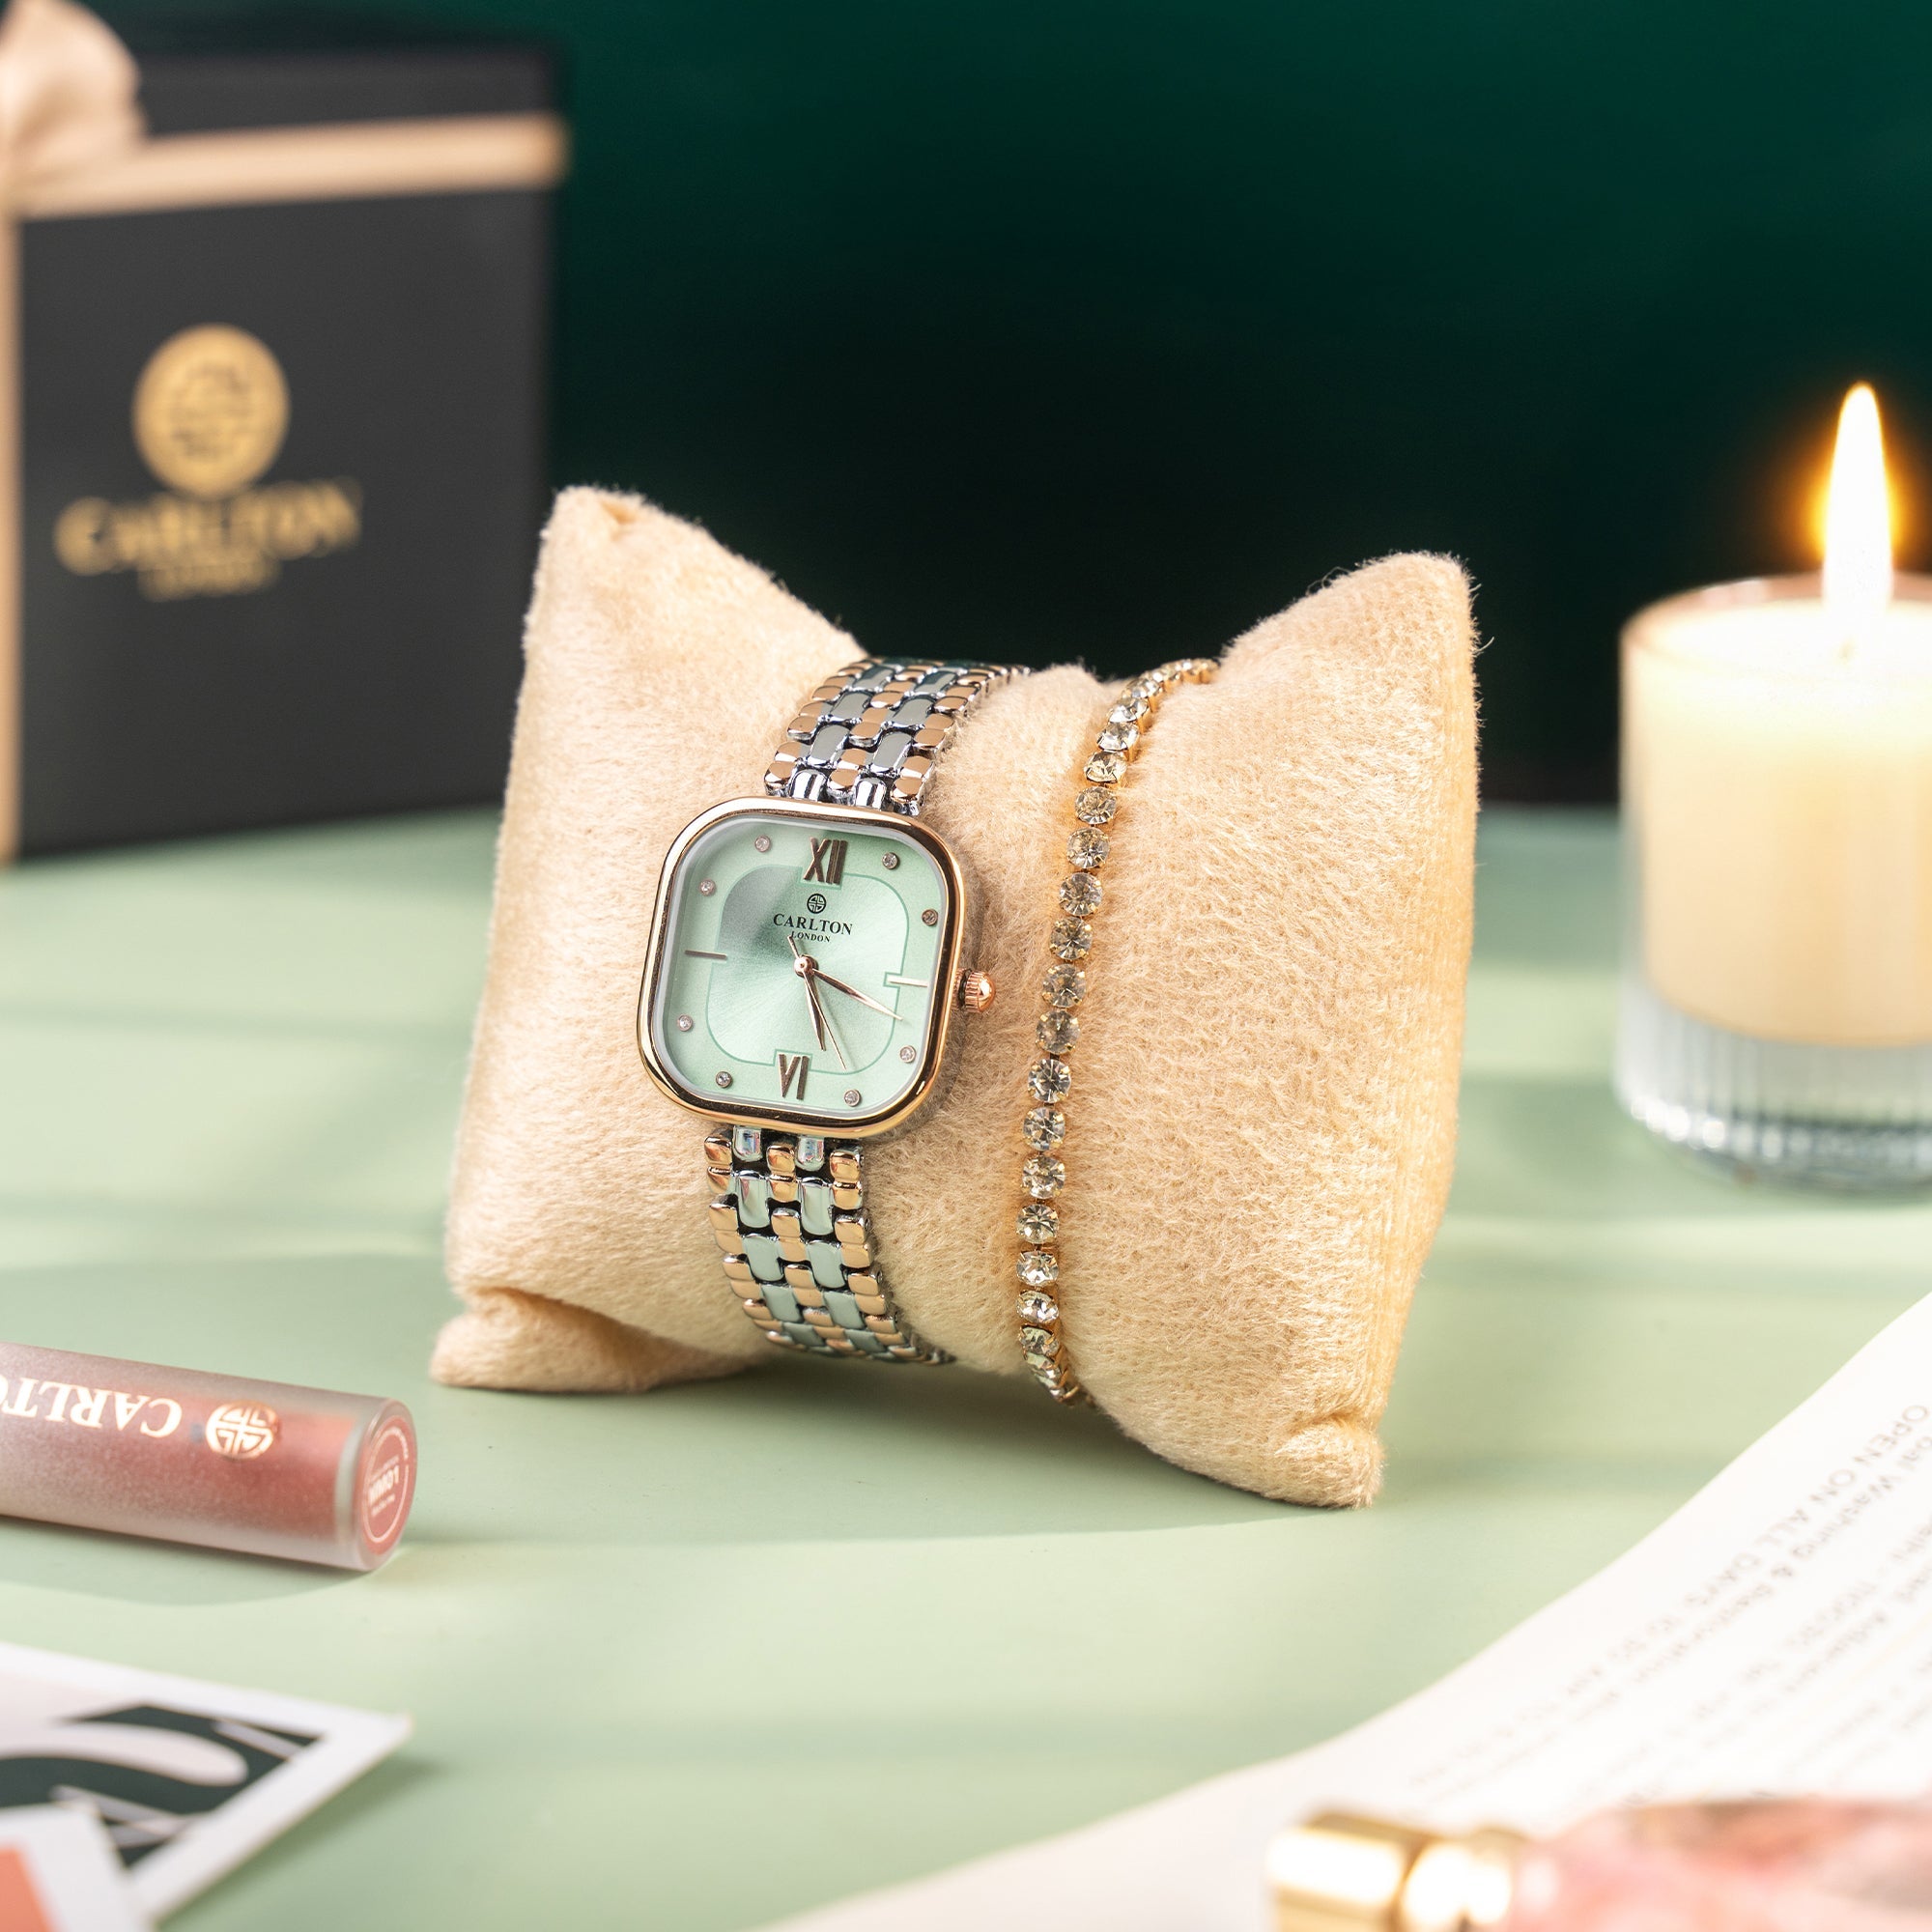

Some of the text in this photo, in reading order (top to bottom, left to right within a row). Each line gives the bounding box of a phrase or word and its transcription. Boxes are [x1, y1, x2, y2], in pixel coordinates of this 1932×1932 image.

[804, 837, 848, 885] XII
[773, 913, 853, 935] CARLTON
[791, 930, 831, 943] LONDON
[779, 1053, 810, 1100] VI
[0, 1374, 183, 1437] CARLT
[1852, 1404, 1929, 1466] OPEN
[1808, 1468, 1858, 1506] ON
